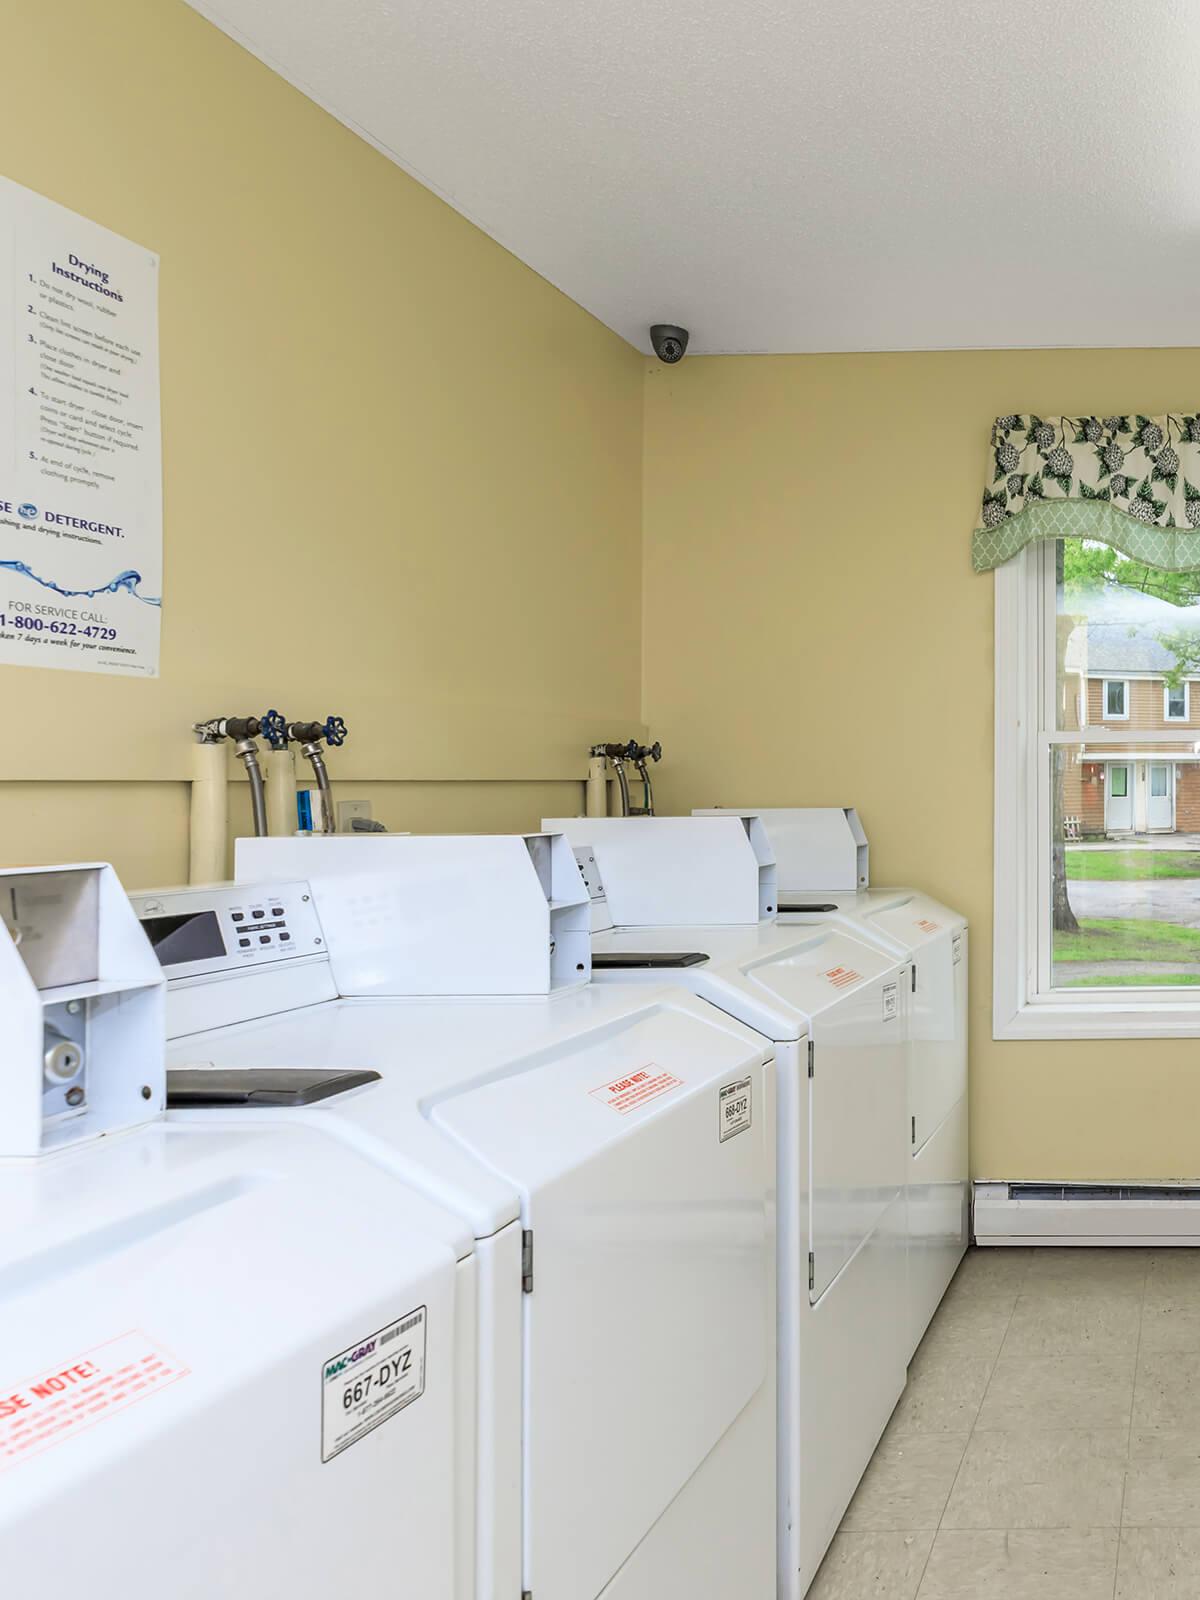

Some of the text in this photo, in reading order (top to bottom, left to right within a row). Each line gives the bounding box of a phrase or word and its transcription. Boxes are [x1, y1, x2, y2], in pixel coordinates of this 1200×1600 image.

[28, 274, 37, 284] 1.
[68, 254, 109, 284] Drying
[52, 262, 124, 302] Instructions
[28, 304, 37, 315] 2.
[28, 334, 37, 344] 3.
[28, 387, 38, 396] 4.
[29, 450, 38, 460] 5.
[38, 526, 60, 538] drying
[44, 511, 125, 538] DETERGENT.
[8, 600, 108, 624] FOR SERVICE CALL:
[0, 614, 117, 640] 1-800-622-4729
[25, 635, 41, 645] days
[50, 638, 68, 647] week
[69, 640, 80, 648] for
[81, 641, 97, 650] your
[608, 1071, 650, 1094] PLEASE NOTE!
[30, 1361, 100, 1399] NOTE!
[343, 1349, 412, 1409] 667-DYZ
